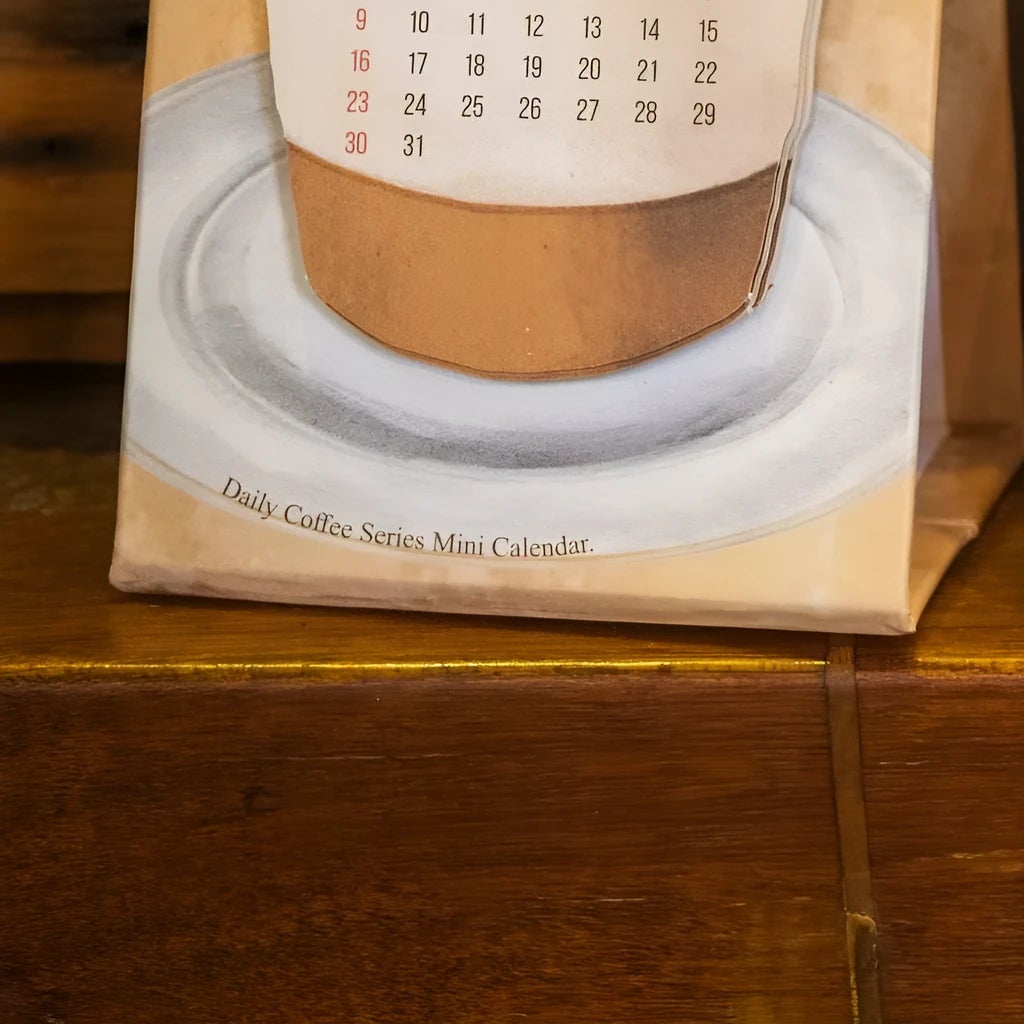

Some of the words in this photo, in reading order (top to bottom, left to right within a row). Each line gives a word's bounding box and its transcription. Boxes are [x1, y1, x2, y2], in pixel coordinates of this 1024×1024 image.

[355, 7, 367, 31] 9
[410, 10, 430, 34] 10
[468, 12, 485, 36] 11
[525, 14, 545, 37] 12
[583, 15, 602, 39] 13
[640, 17, 660, 41] 14
[698, 19, 718, 43] 15
[350, 48, 371, 73] 16
[408, 51, 428, 75] 17
[465, 53, 485, 77] 18
[523, 55, 542, 79] 19
[578, 57, 601, 80] 20
[636, 58, 657, 83] 21
[694, 60, 718, 84] 22
[346, 90, 369, 113] 23
[403, 92, 427, 116] 24
[461, 94, 484, 118] 25
[518, 96, 542, 120] 26
[576, 98, 600, 122] 27
[634, 100, 658, 124] 28
[692, 102, 716, 126] 29
[344, 131, 368, 155] 30
[403, 133, 423, 157] 31
[222, 476, 279, 520] Daily
[284, 504, 353, 538] Coffee
[359, 522, 424, 550] Series
[433, 531, 484, 556] Mini
[492, 536, 594, 558] Calendar.
